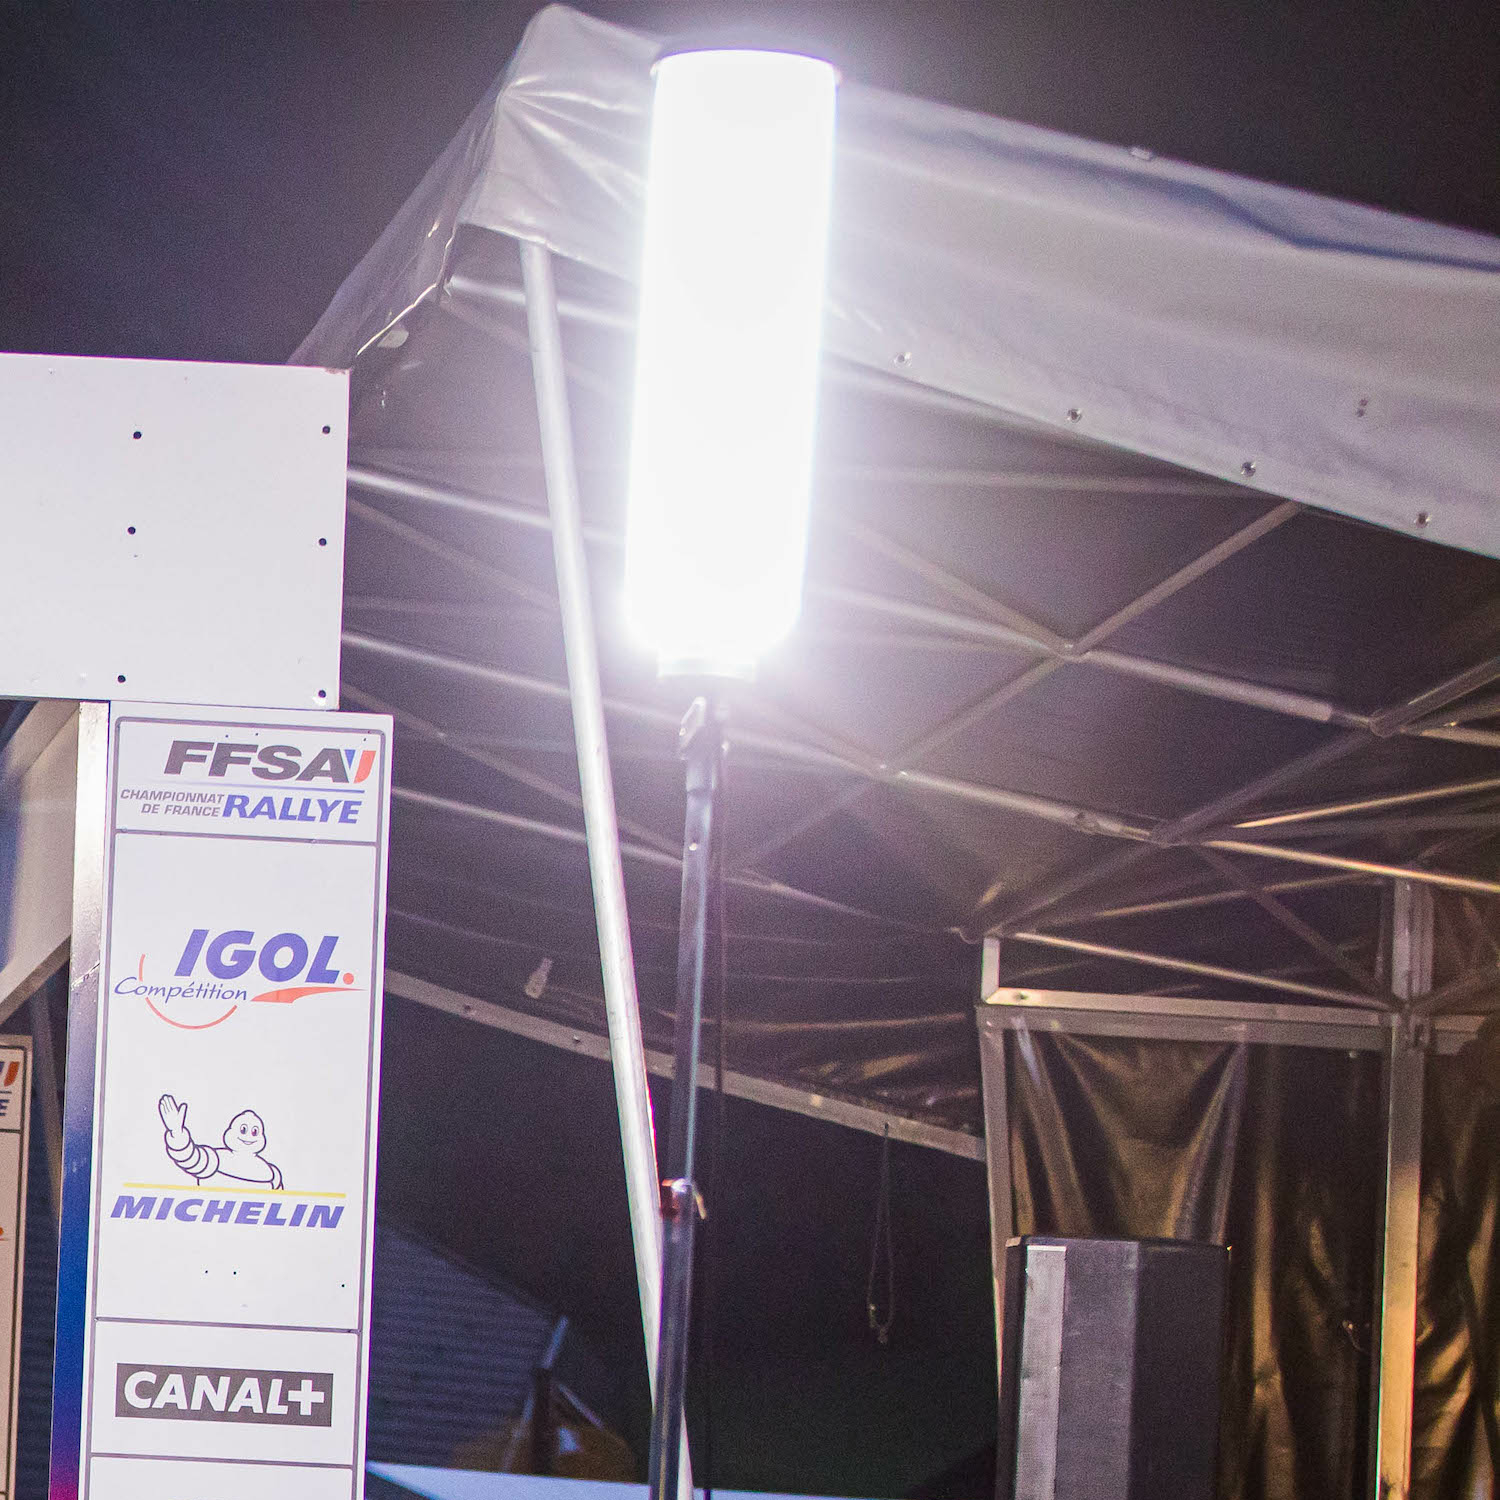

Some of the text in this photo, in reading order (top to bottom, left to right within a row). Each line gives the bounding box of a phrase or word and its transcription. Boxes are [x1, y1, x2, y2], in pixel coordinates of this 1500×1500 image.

[164, 740, 350, 784] FFSA
[120, 788, 225, 805] CHAMPIONNAT
[141, 794, 363, 825] DE FRANCE RALLYE
[114, 975, 248, 1004] Compétition
[110, 1195, 346, 1229] MICHELIN
[123, 1370, 325, 1417] CANAL+
